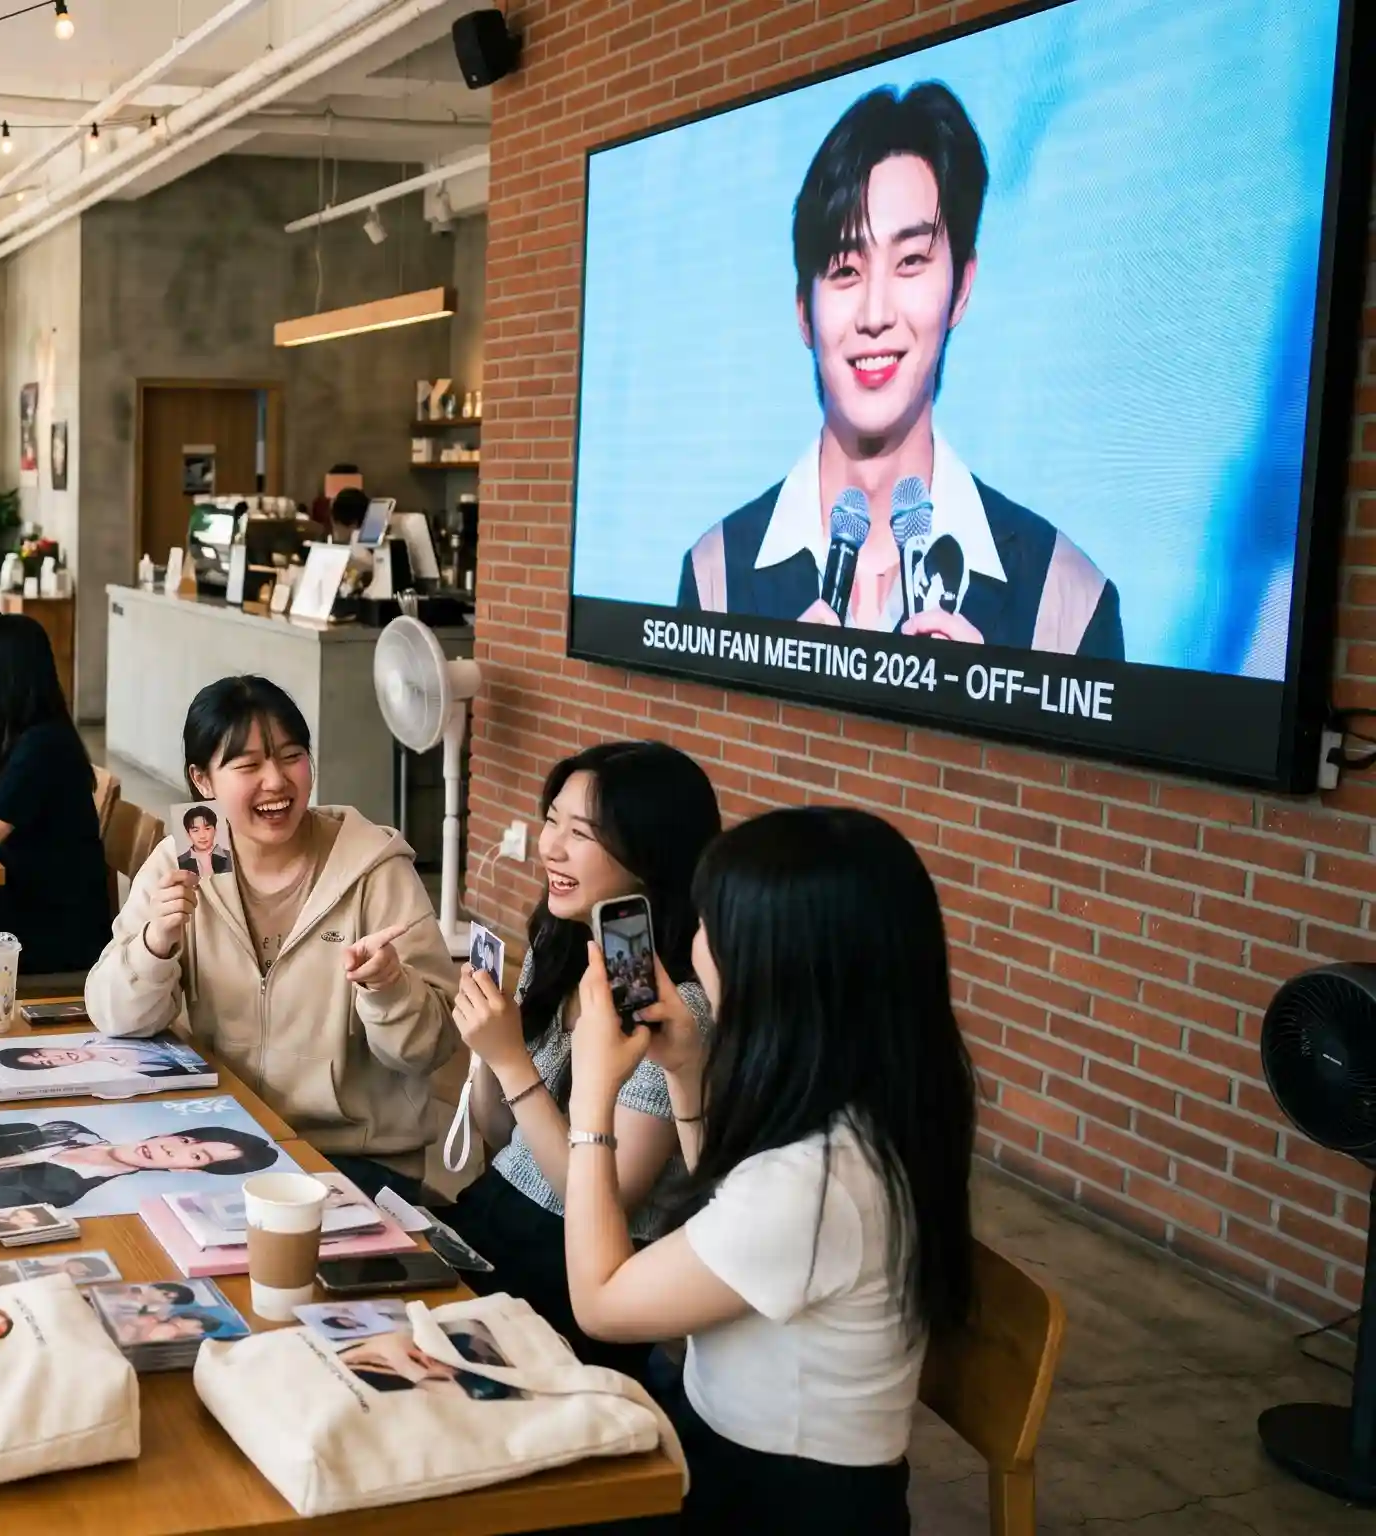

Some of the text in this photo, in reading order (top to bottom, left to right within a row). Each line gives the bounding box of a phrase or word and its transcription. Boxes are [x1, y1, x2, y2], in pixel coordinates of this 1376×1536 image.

[642, 618, 715, 656] SEOJUN
[719, 629, 760, 664] FAN
[764, 635, 867, 681] MEETING
[872, 650, 937, 692] 2024
[966, 663, 1115, 722] OFF-LINE
